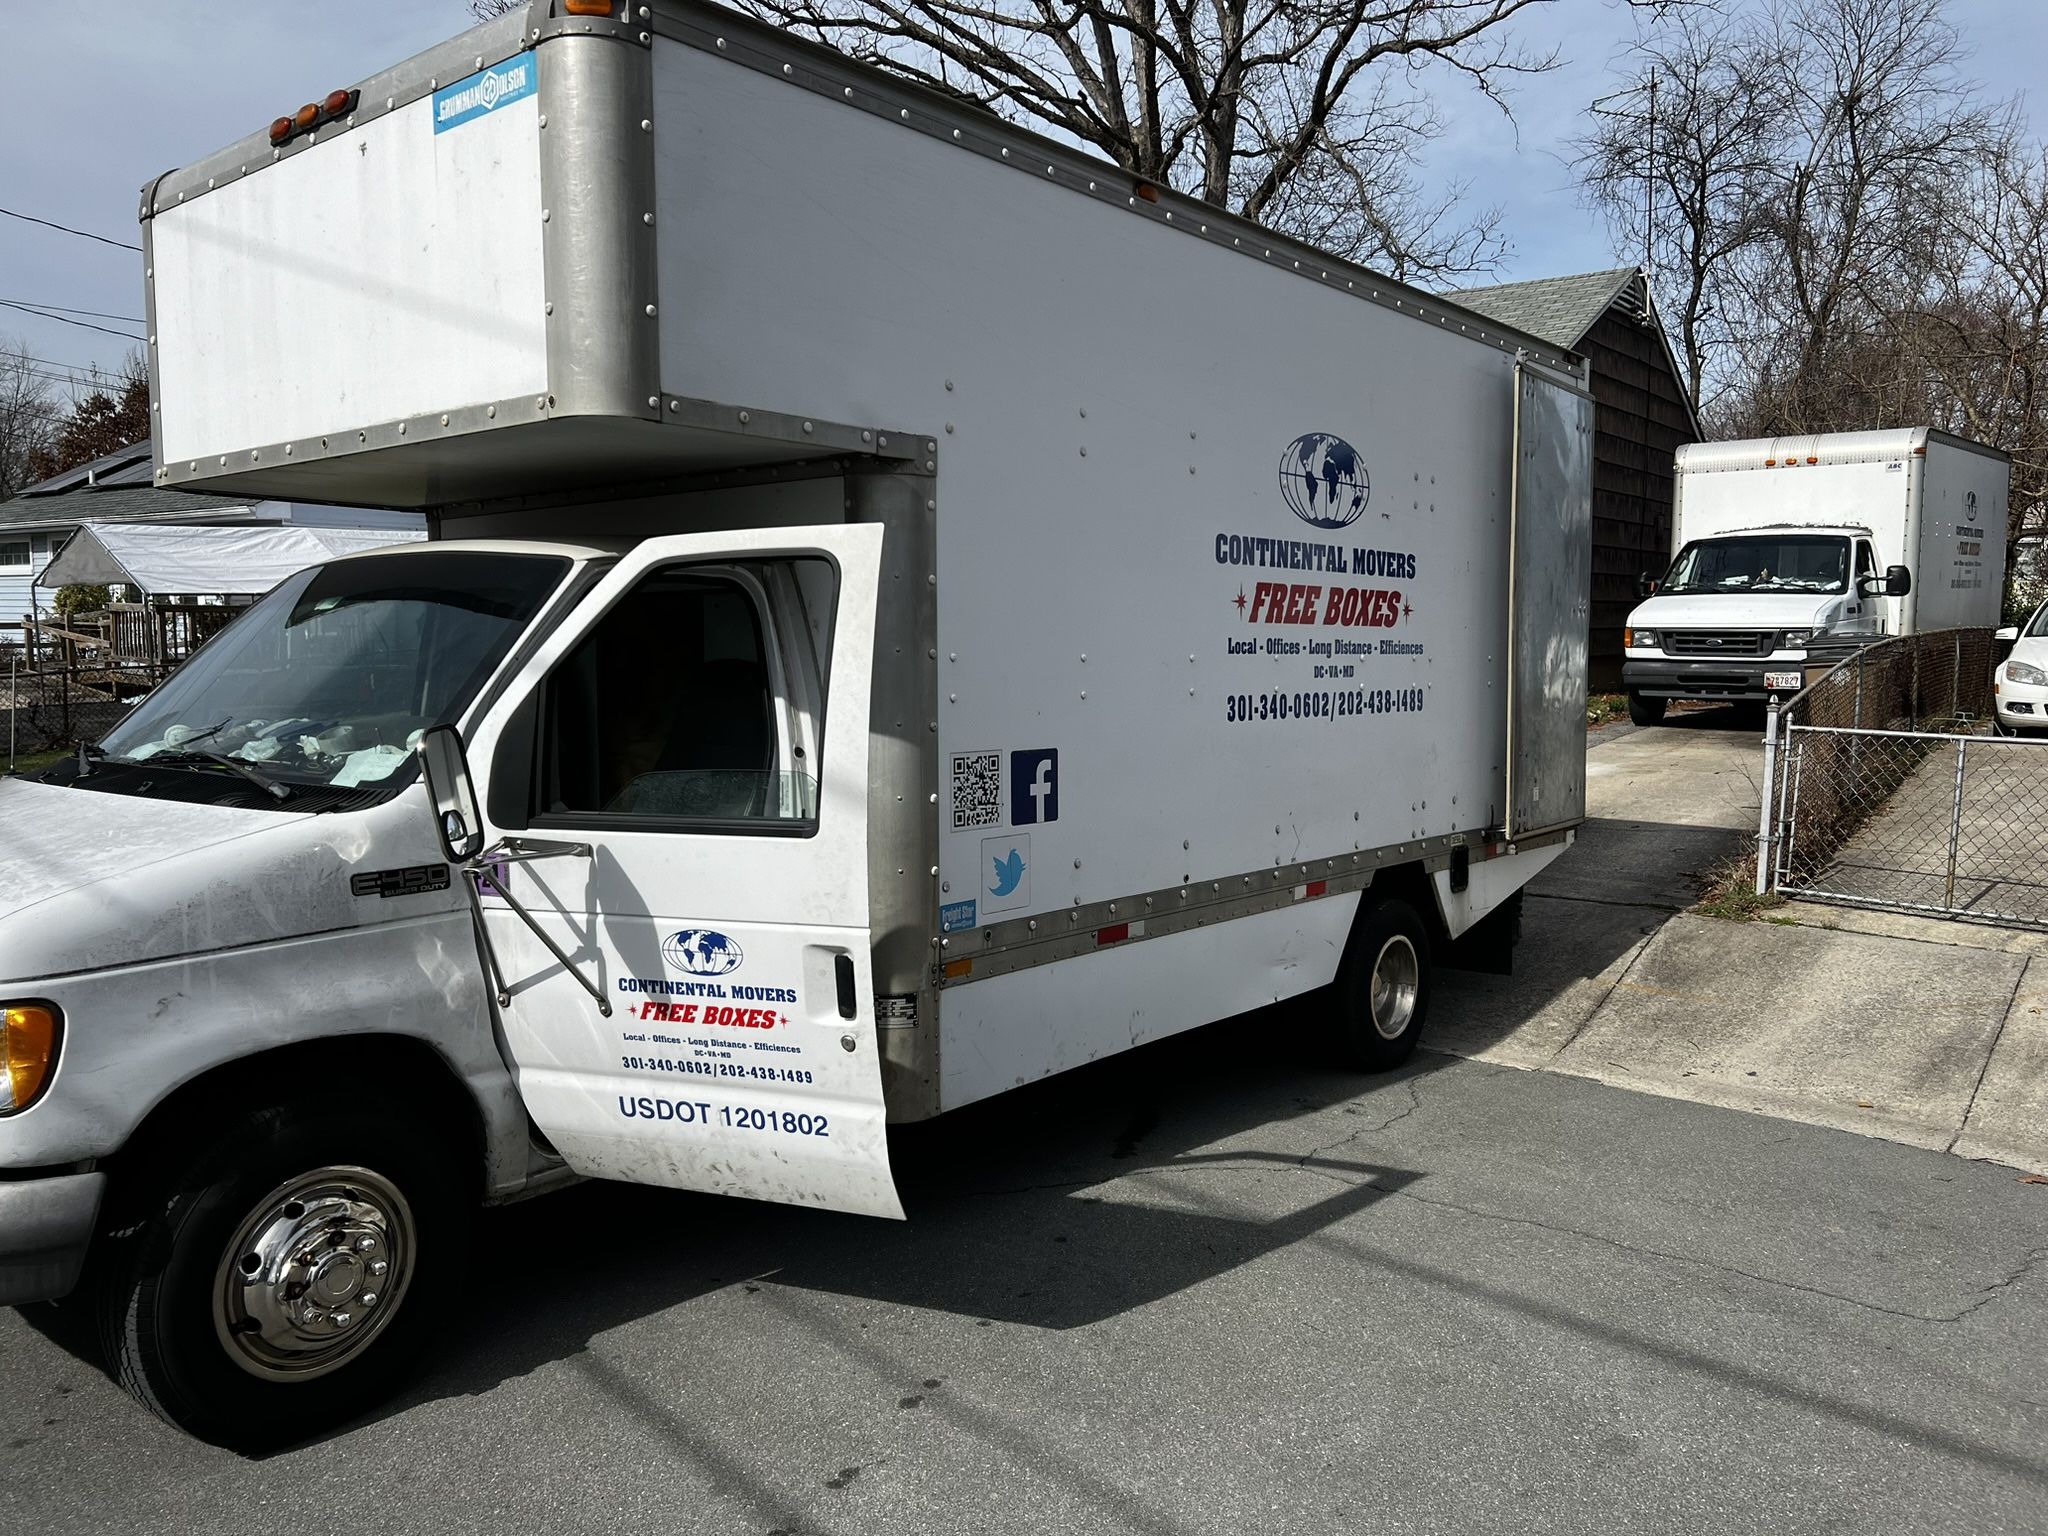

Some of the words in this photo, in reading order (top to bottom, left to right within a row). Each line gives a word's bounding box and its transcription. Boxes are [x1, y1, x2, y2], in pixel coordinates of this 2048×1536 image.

[440, 84, 481, 121] GRUMMAN
[499, 65, 526, 96] OLSON
[1215, 533, 1347, 573] CONTINENTAL
[1352, 548, 1416, 579] MOVERS
[1248, 582, 1322, 625] FREE
[1323, 587, 1402, 628] BOXES
[1227, 637, 1257, 655] Local
[1266, 637, 1300, 655] Offices
[1308, 638, 1332, 659] Long
[1334, 639, 1372, 655] Distance
[1379, 640, 1424, 655] Efficiences
[384, 886, 418, 897] SUPER
[420, 882, 447, 892] DUTY
[618, 977, 726, 998] CONTINENTAL
[731, 985, 797, 1003] MOVERS
[639, 1001, 699, 1023] FREE
[702, 1006, 777, 1029] BOXES
[622, 1032, 646, 1042] Local
[652, 1034, 681, 1045] Offices
[687, 1037, 709, 1048] Long
[711, 1039, 747, 1050] Distance
[754, 1042, 801, 1054] Efficiences
[618, 1095, 711, 1125] USDOT
[720, 1104, 830, 1137] 1201802
